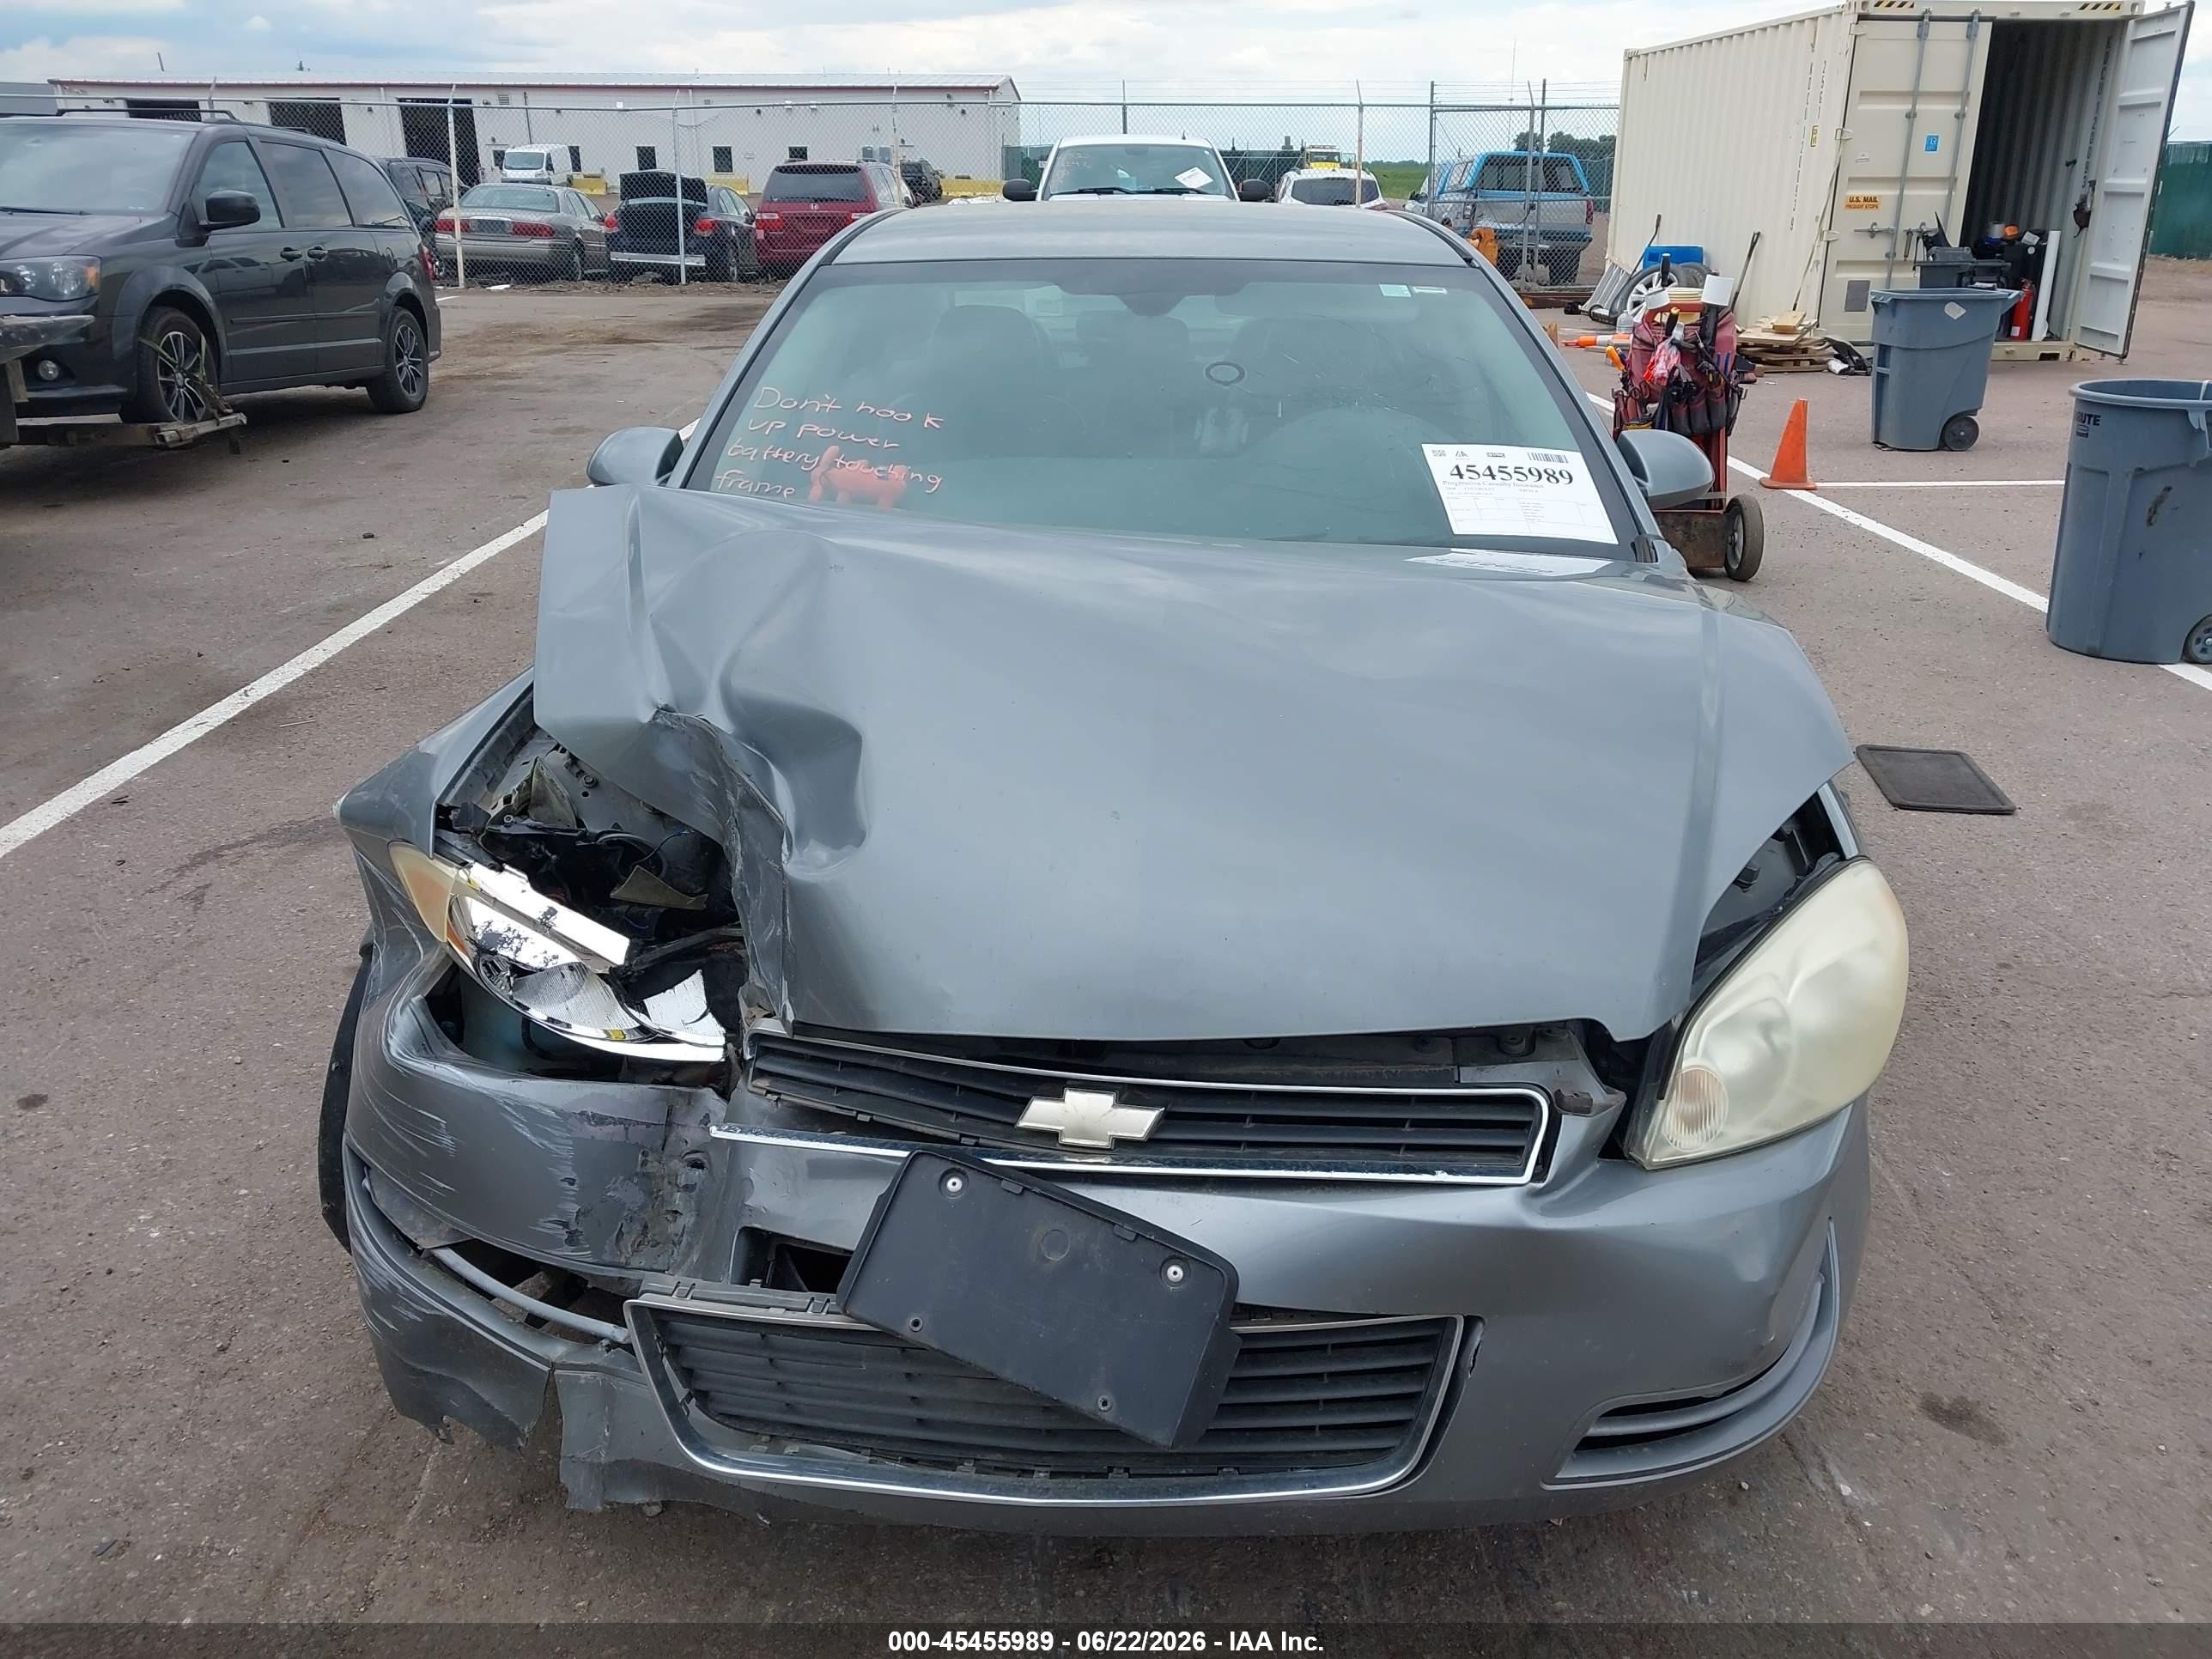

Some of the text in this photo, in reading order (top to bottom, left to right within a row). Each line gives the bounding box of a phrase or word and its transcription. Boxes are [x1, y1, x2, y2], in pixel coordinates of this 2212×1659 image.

[753, 386, 842, 413] Don't
[727, 436, 943, 494] battery touching
[1449, 465, 1574, 486] 45455989
[715, 469, 796, 500] frame
